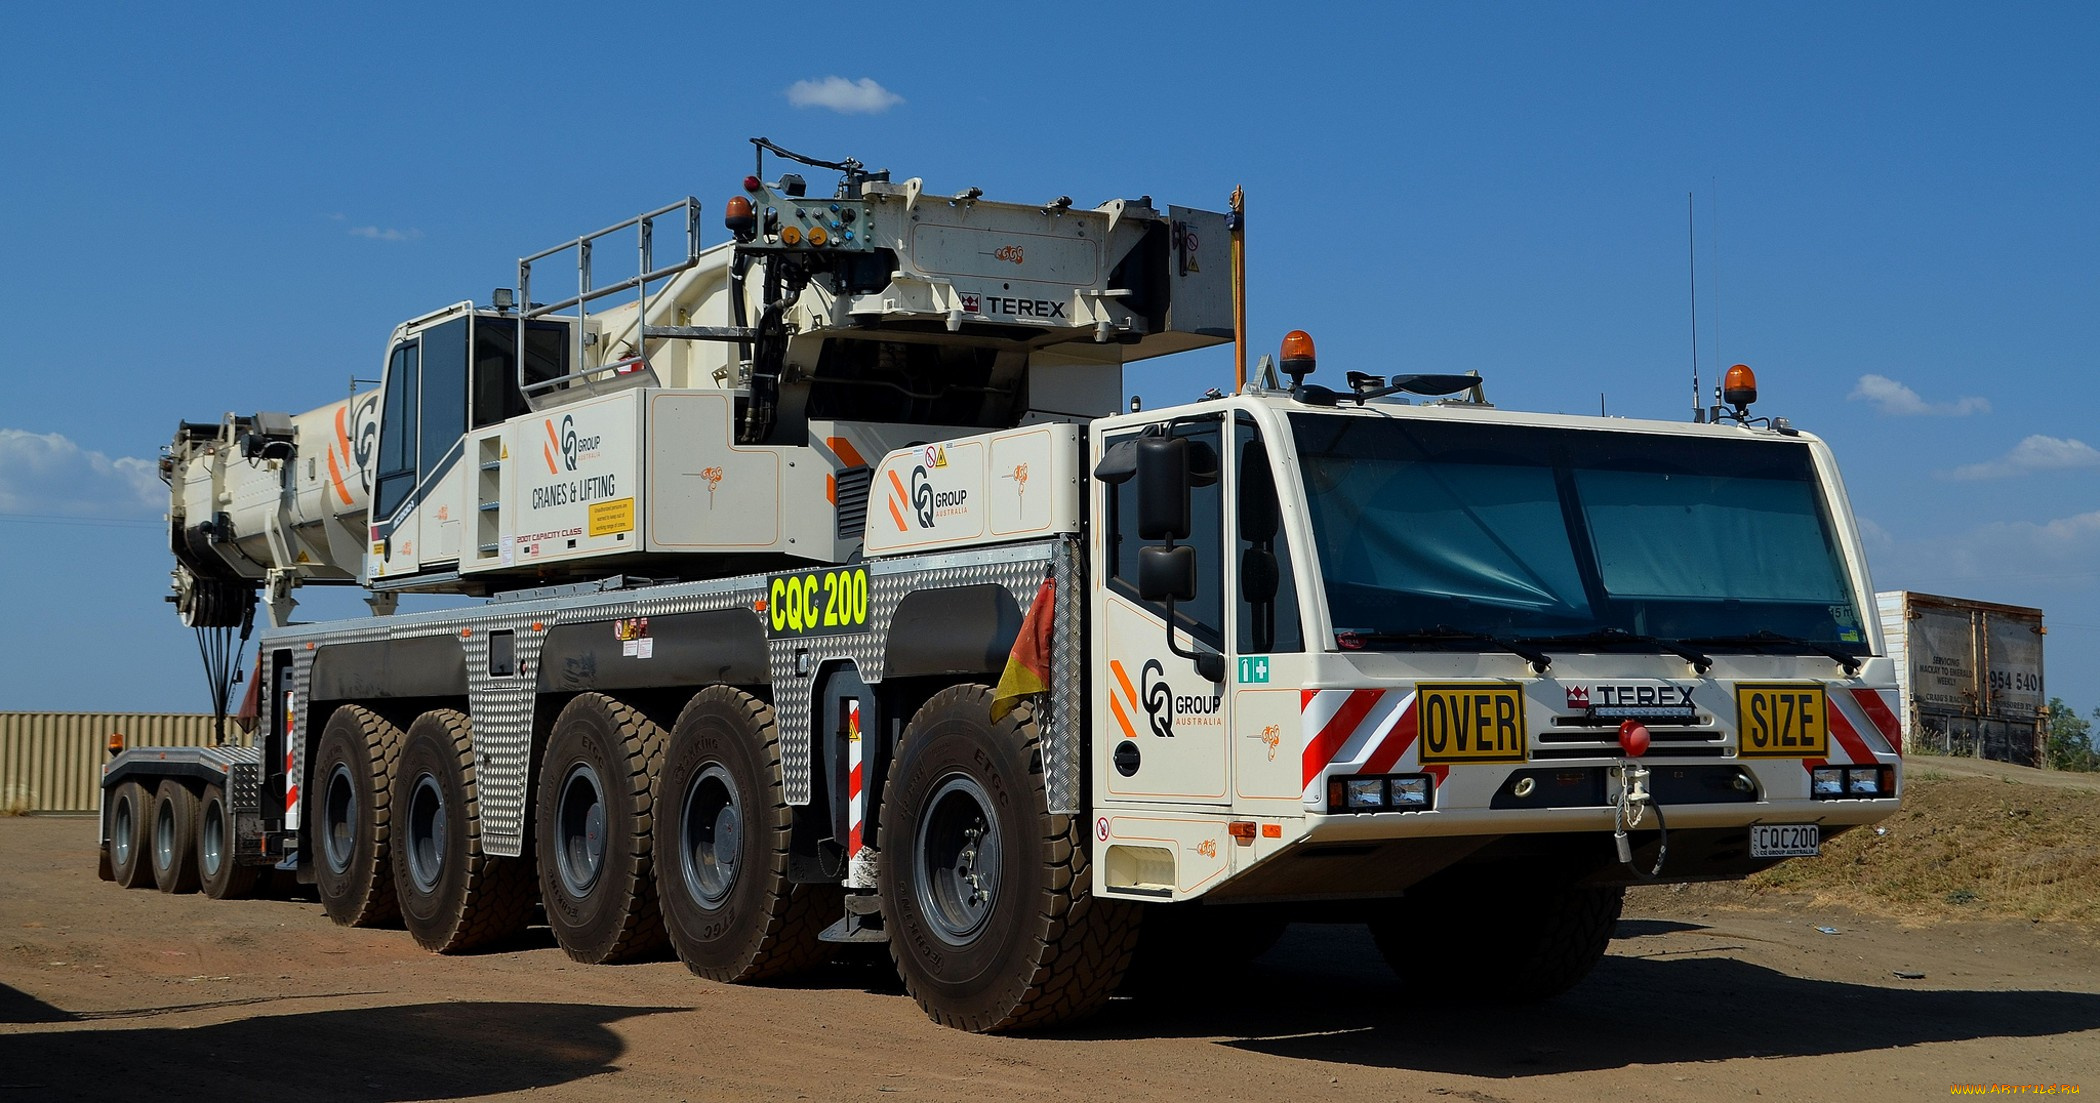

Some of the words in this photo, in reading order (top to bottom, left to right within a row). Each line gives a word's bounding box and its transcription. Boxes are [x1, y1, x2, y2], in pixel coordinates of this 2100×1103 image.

[986, 296, 1065, 319] TEREX
[578, 435, 600, 452] GROUP
[532, 482, 568, 510] CRANES
[570, 481, 577, 503] &
[579, 473, 615, 502] LIFTING
[935, 489, 967, 508] GROUP
[935, 506, 968, 518] AUSTRALIA
[516, 534, 532, 544] 200T
[532, 531, 561, 541] CAPACITY
[562, 527, 582, 537] CLASS
[771, 574, 818, 634] CQC
[824, 568, 867, 627] 200
[1933, 655, 1960, 667] SERVICING
[1919, 664, 1941, 675] MACKAY
[1941, 666, 1949, 676] TO
[1950, 667, 1973, 679] EMERALD
[1937, 675, 1957, 686] WEEKLY
[2016, 672, 2043, 692] 5401
[1141, 658, 1175, 738] CQ
[1175, 695, 1221, 714] GROUP
[1597, 686, 1695, 705] TEREX
[1175, 717, 1222, 726] AUSTRALIA
[1427, 694, 1518, 753] OVER
[1751, 693, 1814, 748] SIZE
[973, 748, 1009, 808] ETGC
[1760, 827, 1817, 849] CQC200
